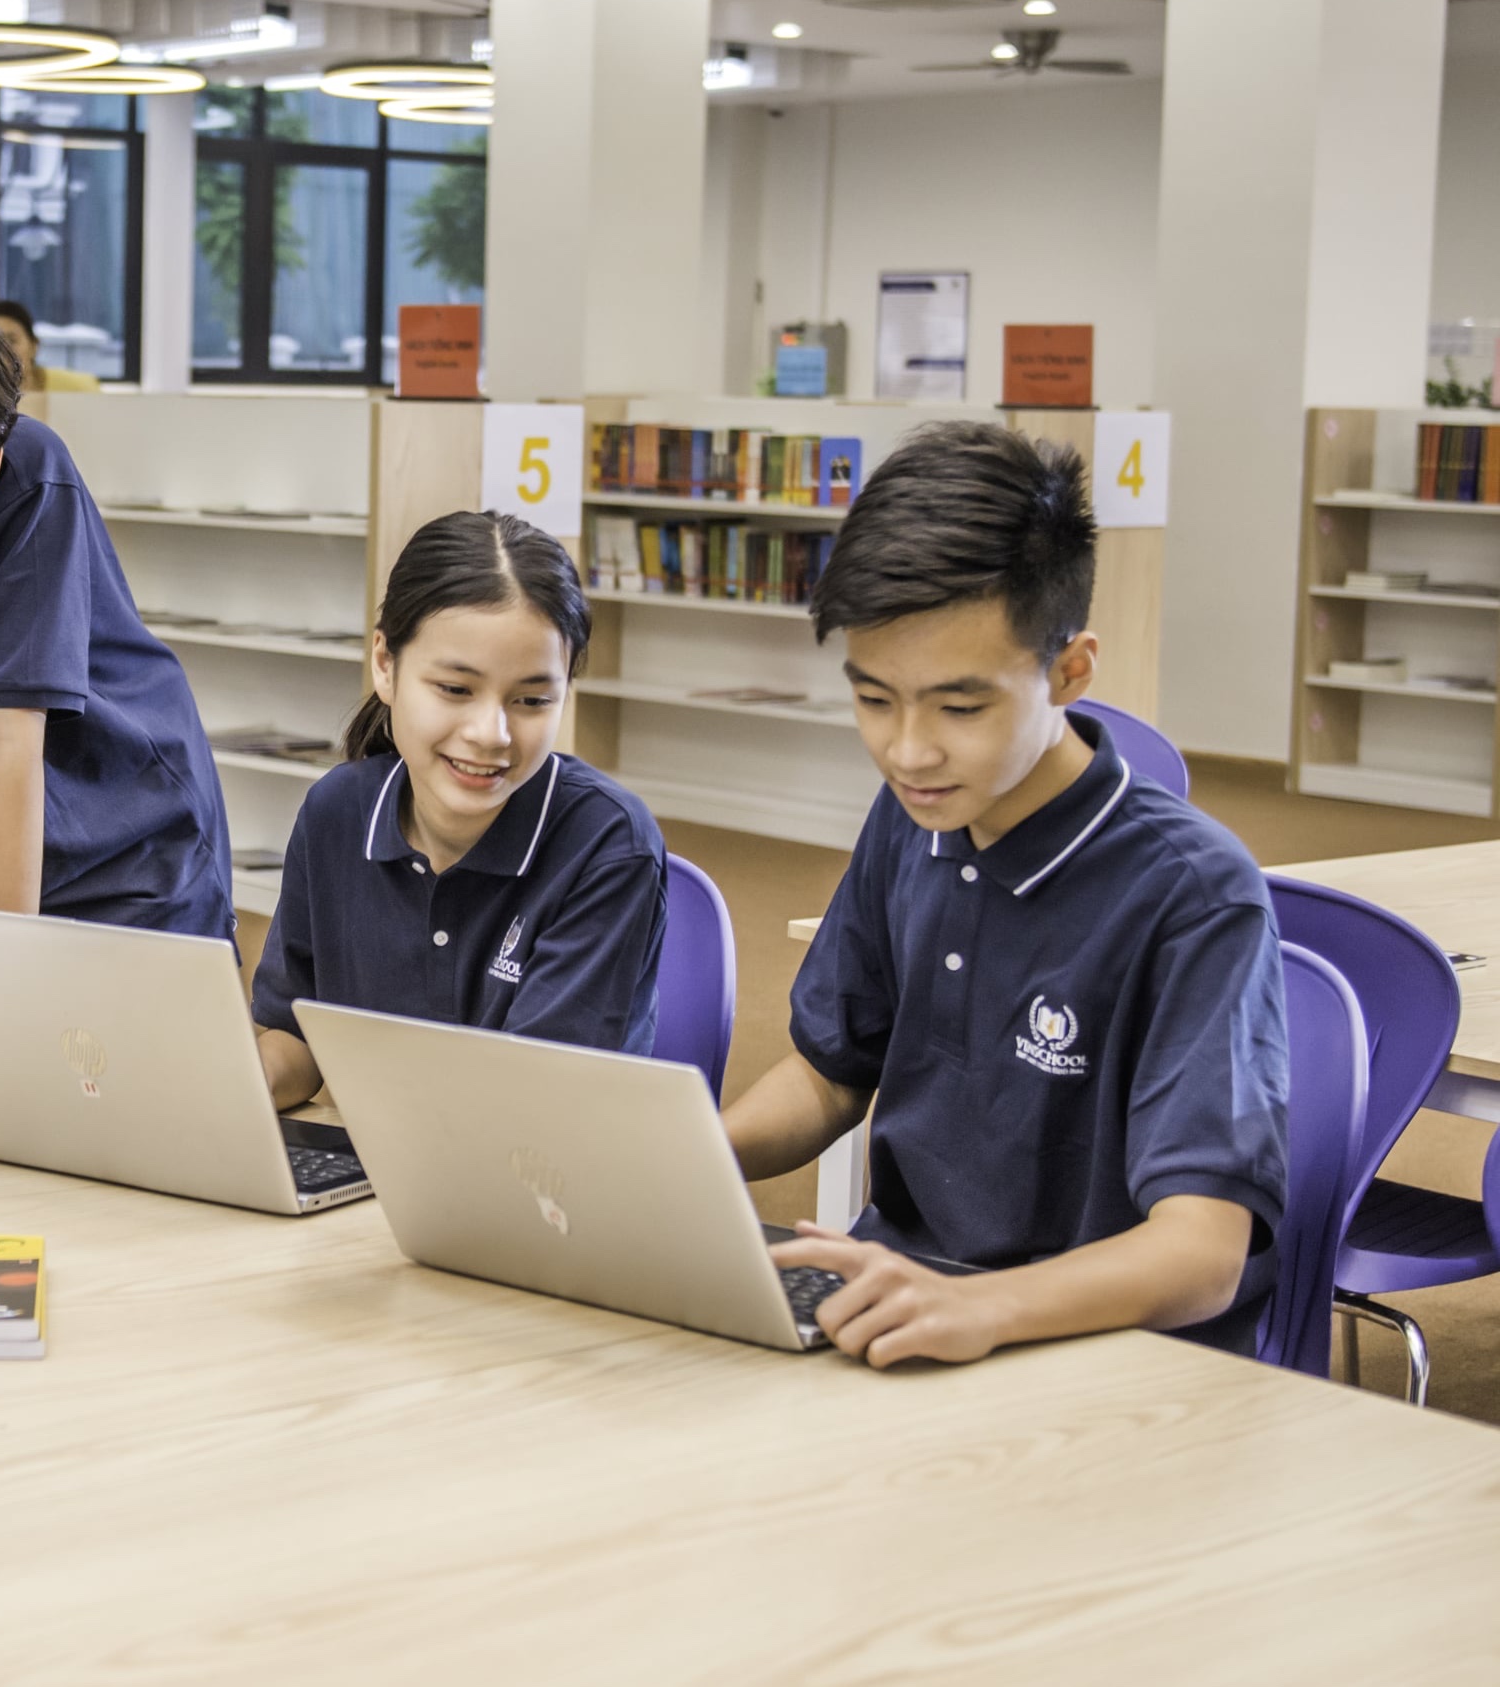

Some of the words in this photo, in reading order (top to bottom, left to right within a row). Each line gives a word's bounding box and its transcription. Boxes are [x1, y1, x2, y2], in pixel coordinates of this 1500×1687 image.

[517, 437, 551, 504] 5
[1117, 440, 1145, 498] 4
[1015, 1035, 1089, 1067] VINSCHOOL
